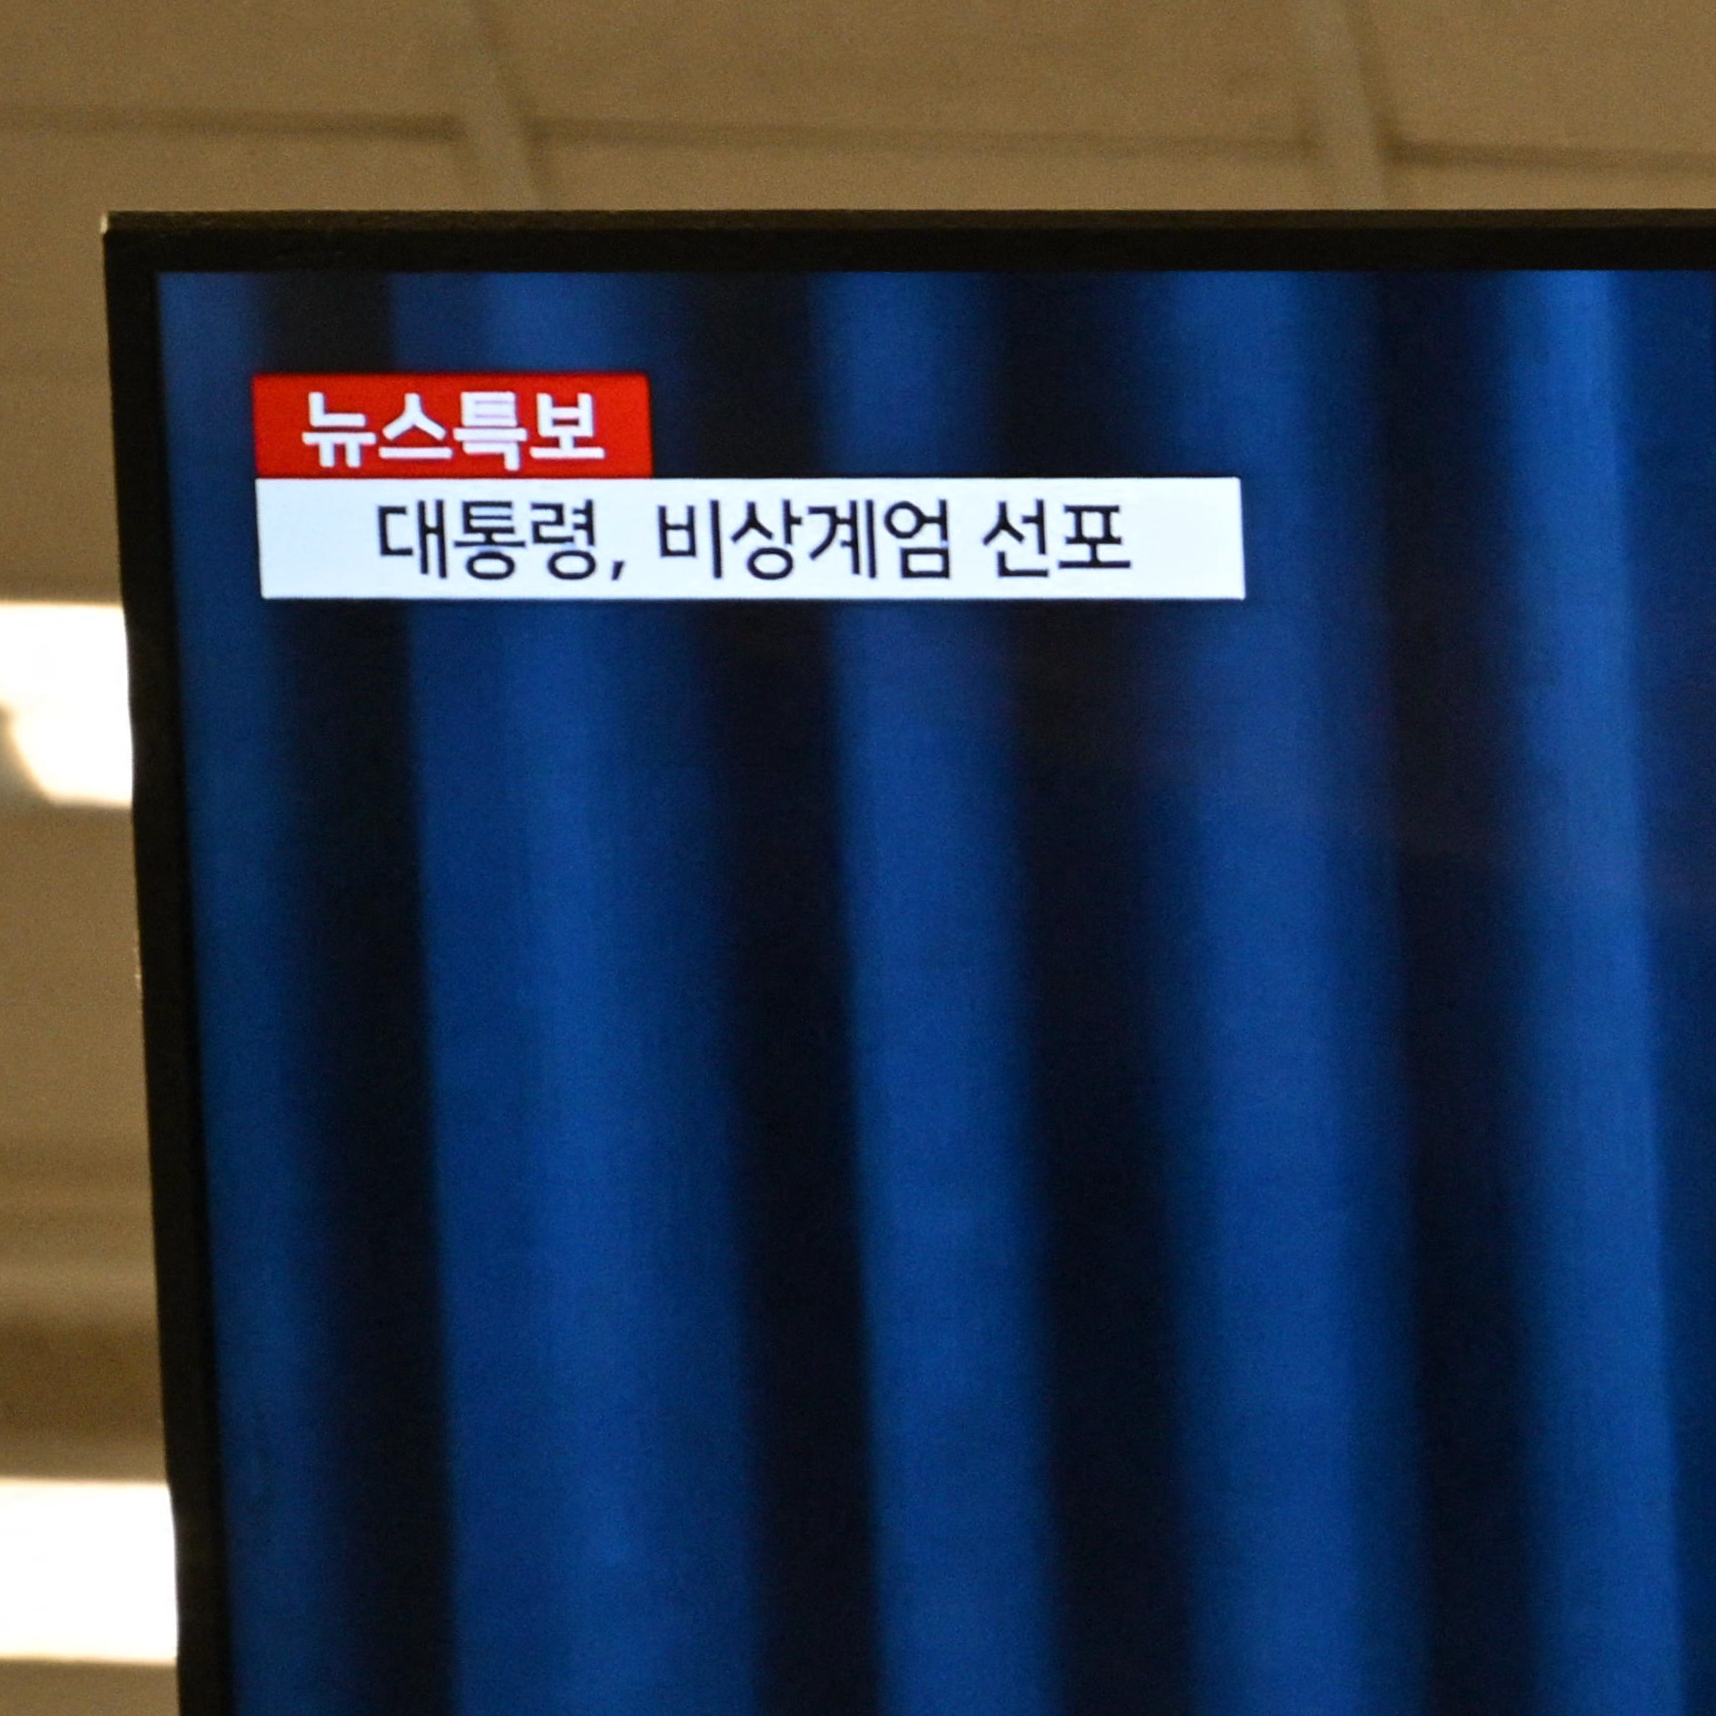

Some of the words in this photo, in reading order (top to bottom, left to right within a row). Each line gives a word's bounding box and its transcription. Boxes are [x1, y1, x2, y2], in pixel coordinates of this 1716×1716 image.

[301, 391, 606, 471] 뉴스특보
[377, 498, 626, 582] 대통령,
[657, 499, 951, 581] 비상계엄
[982, 499, 1133, 579] 선포
